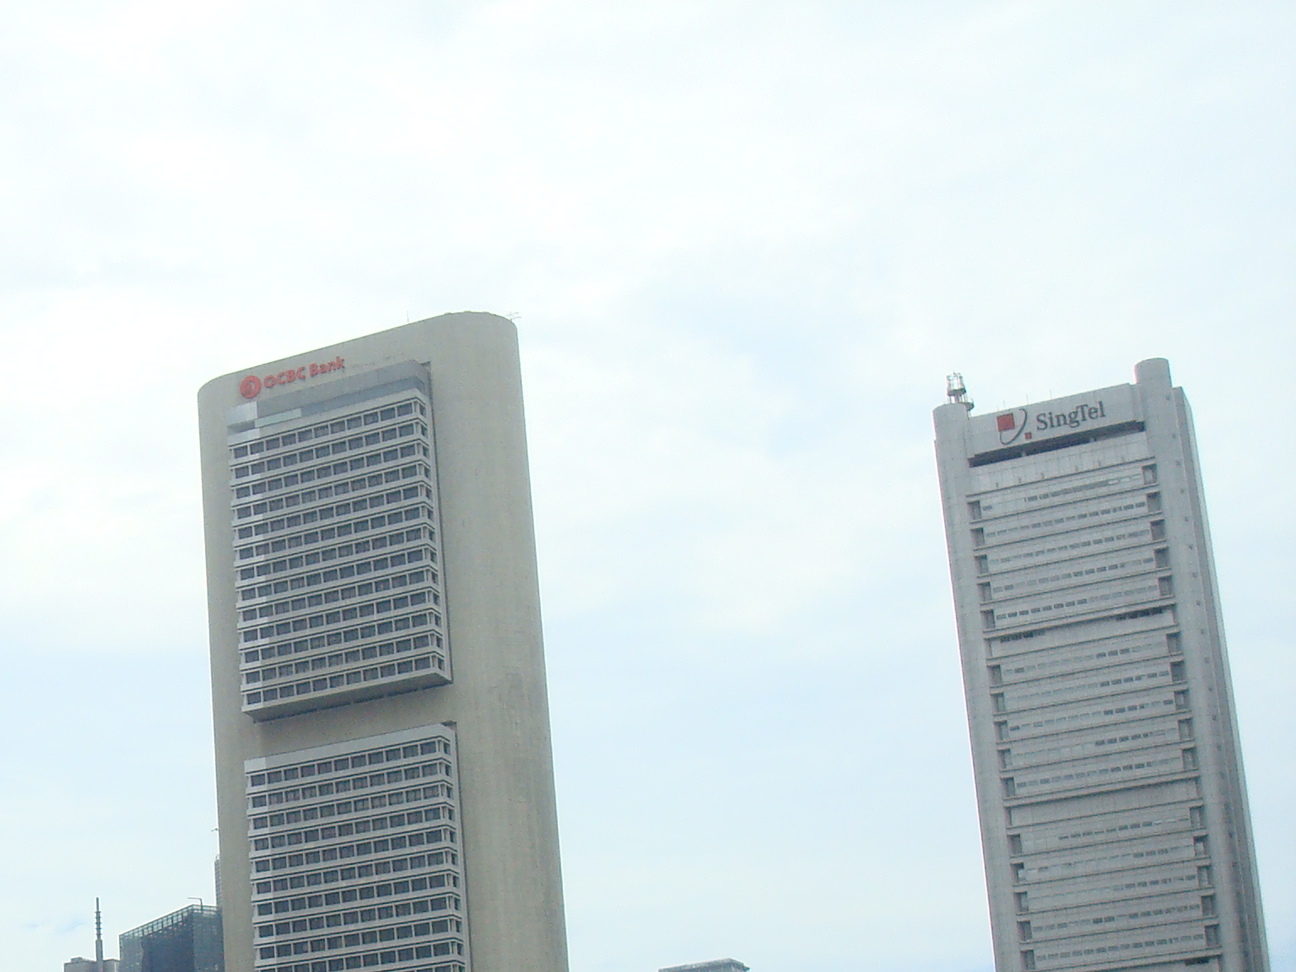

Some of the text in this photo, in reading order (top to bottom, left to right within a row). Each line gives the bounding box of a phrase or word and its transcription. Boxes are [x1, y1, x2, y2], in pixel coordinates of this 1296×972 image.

[263, 355, 345, 388] OCBC Bank
[1036, 400, 1106, 431] SingTel
